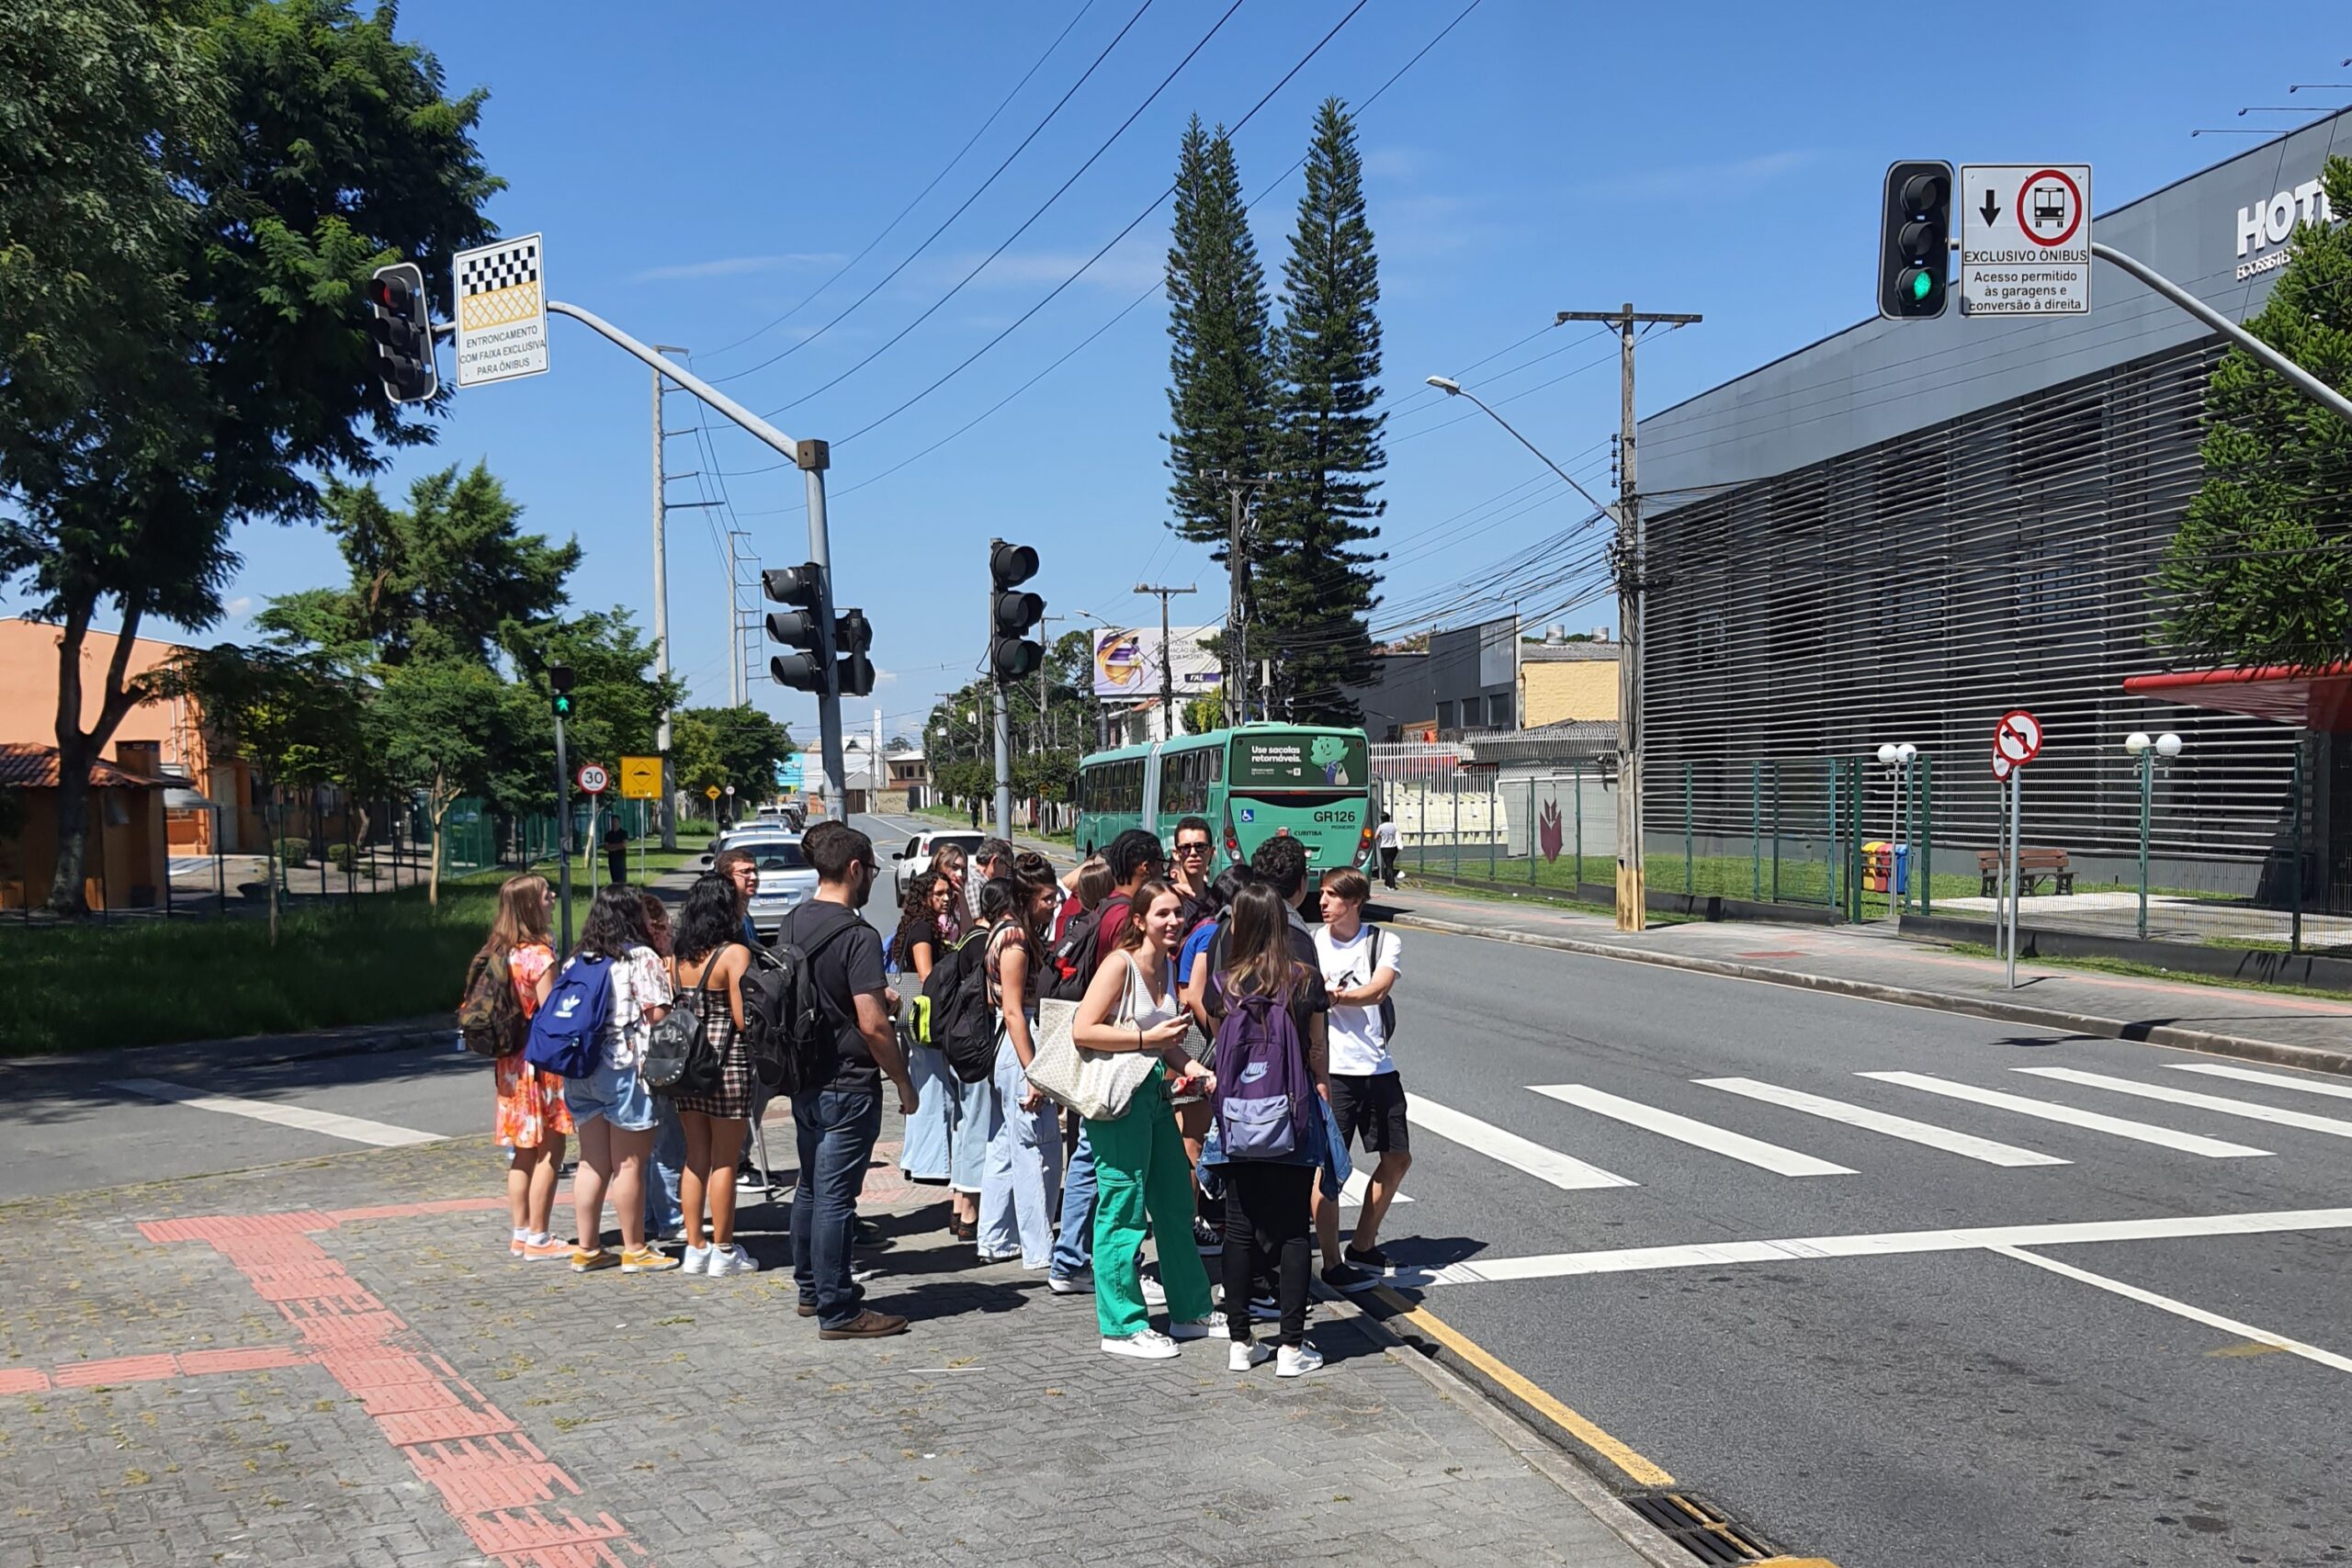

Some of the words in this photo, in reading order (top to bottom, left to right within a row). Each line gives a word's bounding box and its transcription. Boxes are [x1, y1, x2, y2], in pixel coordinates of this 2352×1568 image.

[1964, 251, 2036, 263] EXCLUSIVO
[2040, 248, 2087, 262] ÔNIBUS
[1974, 272, 2018, 282] Acesso
[2021, 271, 2077, 284] permitido
[1984, 287, 1998, 297] às
[2002, 287, 2056, 299] garagens
[2060, 288, 2067, 296] e
[1969, 299, 2031, 310] conversão
[2034, 299, 2041, 310] à
[2044, 299, 2081, 310] direita
[467, 325, 538, 348] ENTRONCAMENTO
[460, 353, 479, 365] COM
[480, 349, 502, 362] FAIXA
[503, 338, 546, 356] EXCLUSIVA
[477, 362, 499, 377] PARA
[499, 356, 530, 372] ÔNIBUS
[1251, 745, 1268, 754] Use
[1269, 745, 1301, 754] sacolas
[1251, 753, 1302, 762] retornáveis.
[585, 772, 604, 784] 30
[1314, 810, 1355, 822] GR126
